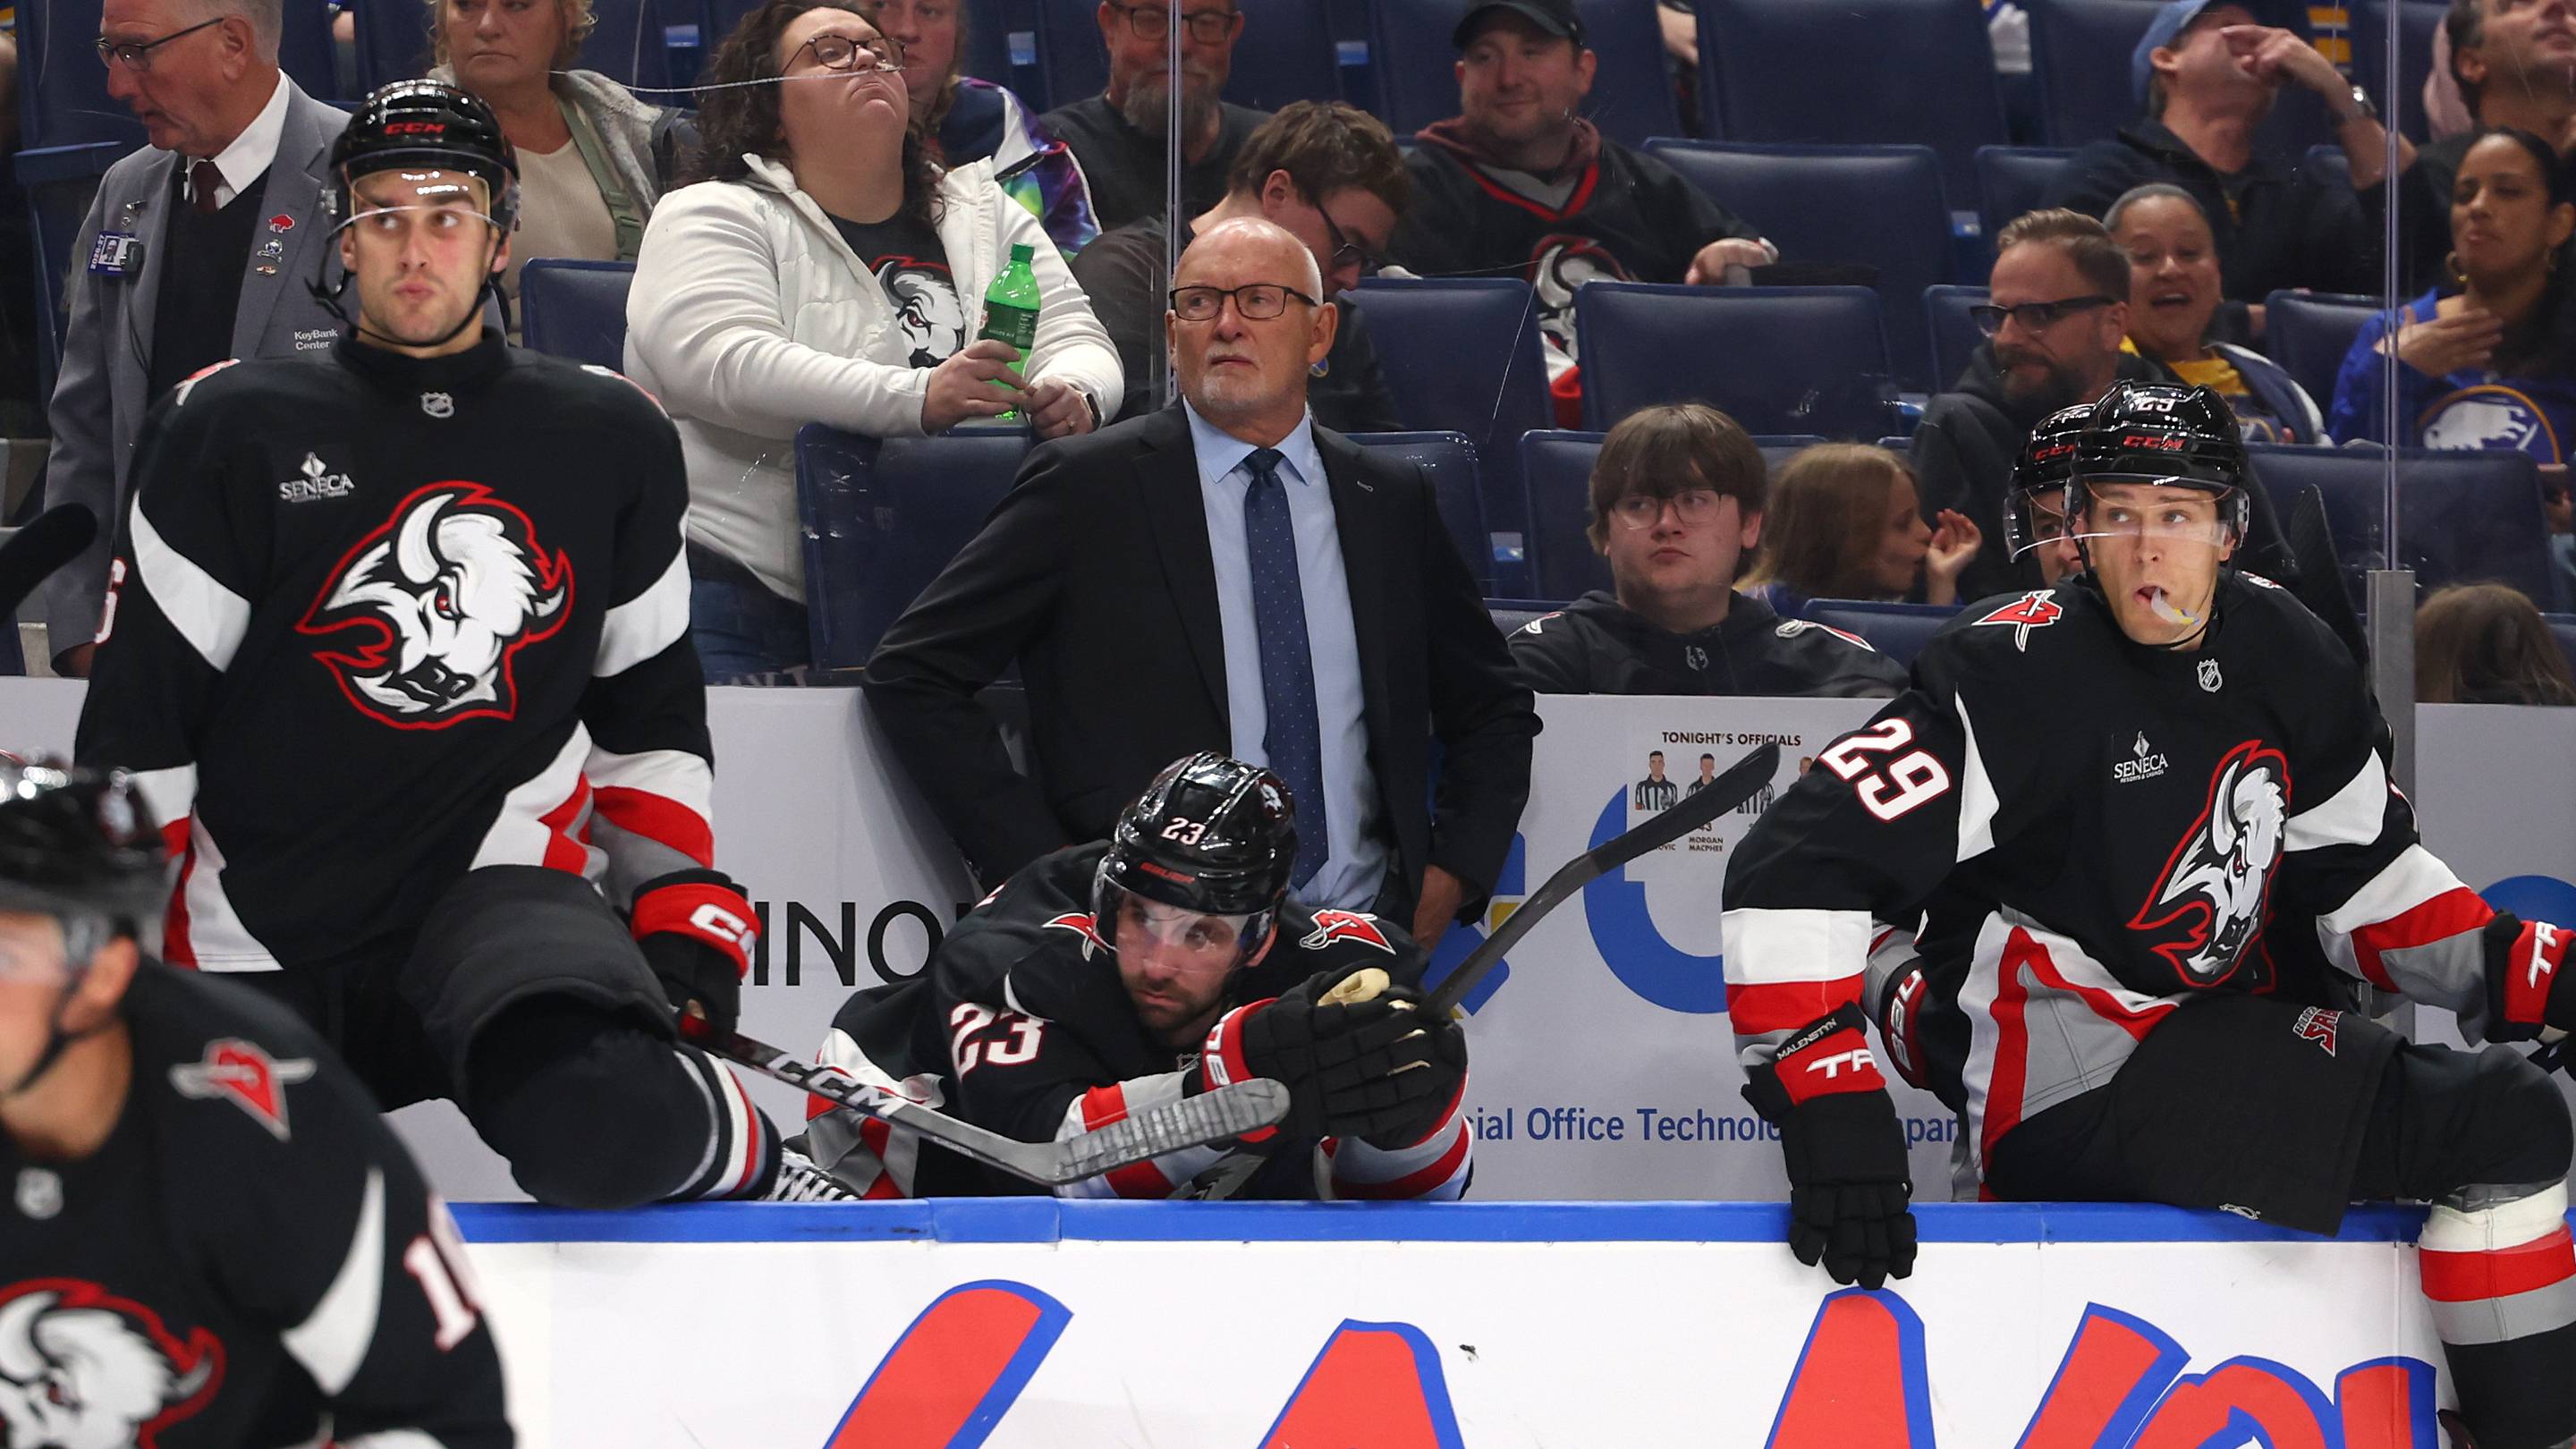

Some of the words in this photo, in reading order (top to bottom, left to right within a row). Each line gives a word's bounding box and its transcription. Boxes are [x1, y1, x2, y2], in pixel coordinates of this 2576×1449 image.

[386, 122, 445, 135] CCM
[294, 329, 338, 341] KeyBank
[296, 341, 330, 351] Center
[2123, 436, 2185, 451] CCM
[279, 473, 355, 500] SENECA
[1662, 732, 1733, 744] TONIGHT'S
[1738, 733, 1801, 746] OFFICIALS
[1816, 716, 1953, 825] 29
[2114, 753, 2169, 779] SENECA
[1160, 817, 1207, 845] 23
[949, 1001, 1045, 1084] 23
[1776, 1018, 1838, 1060] MALENSTYN
[767, 1053, 910, 1118] CCM
[1465, 1106, 1513, 1140] ial
[1527, 1106, 1624, 1140] Office
